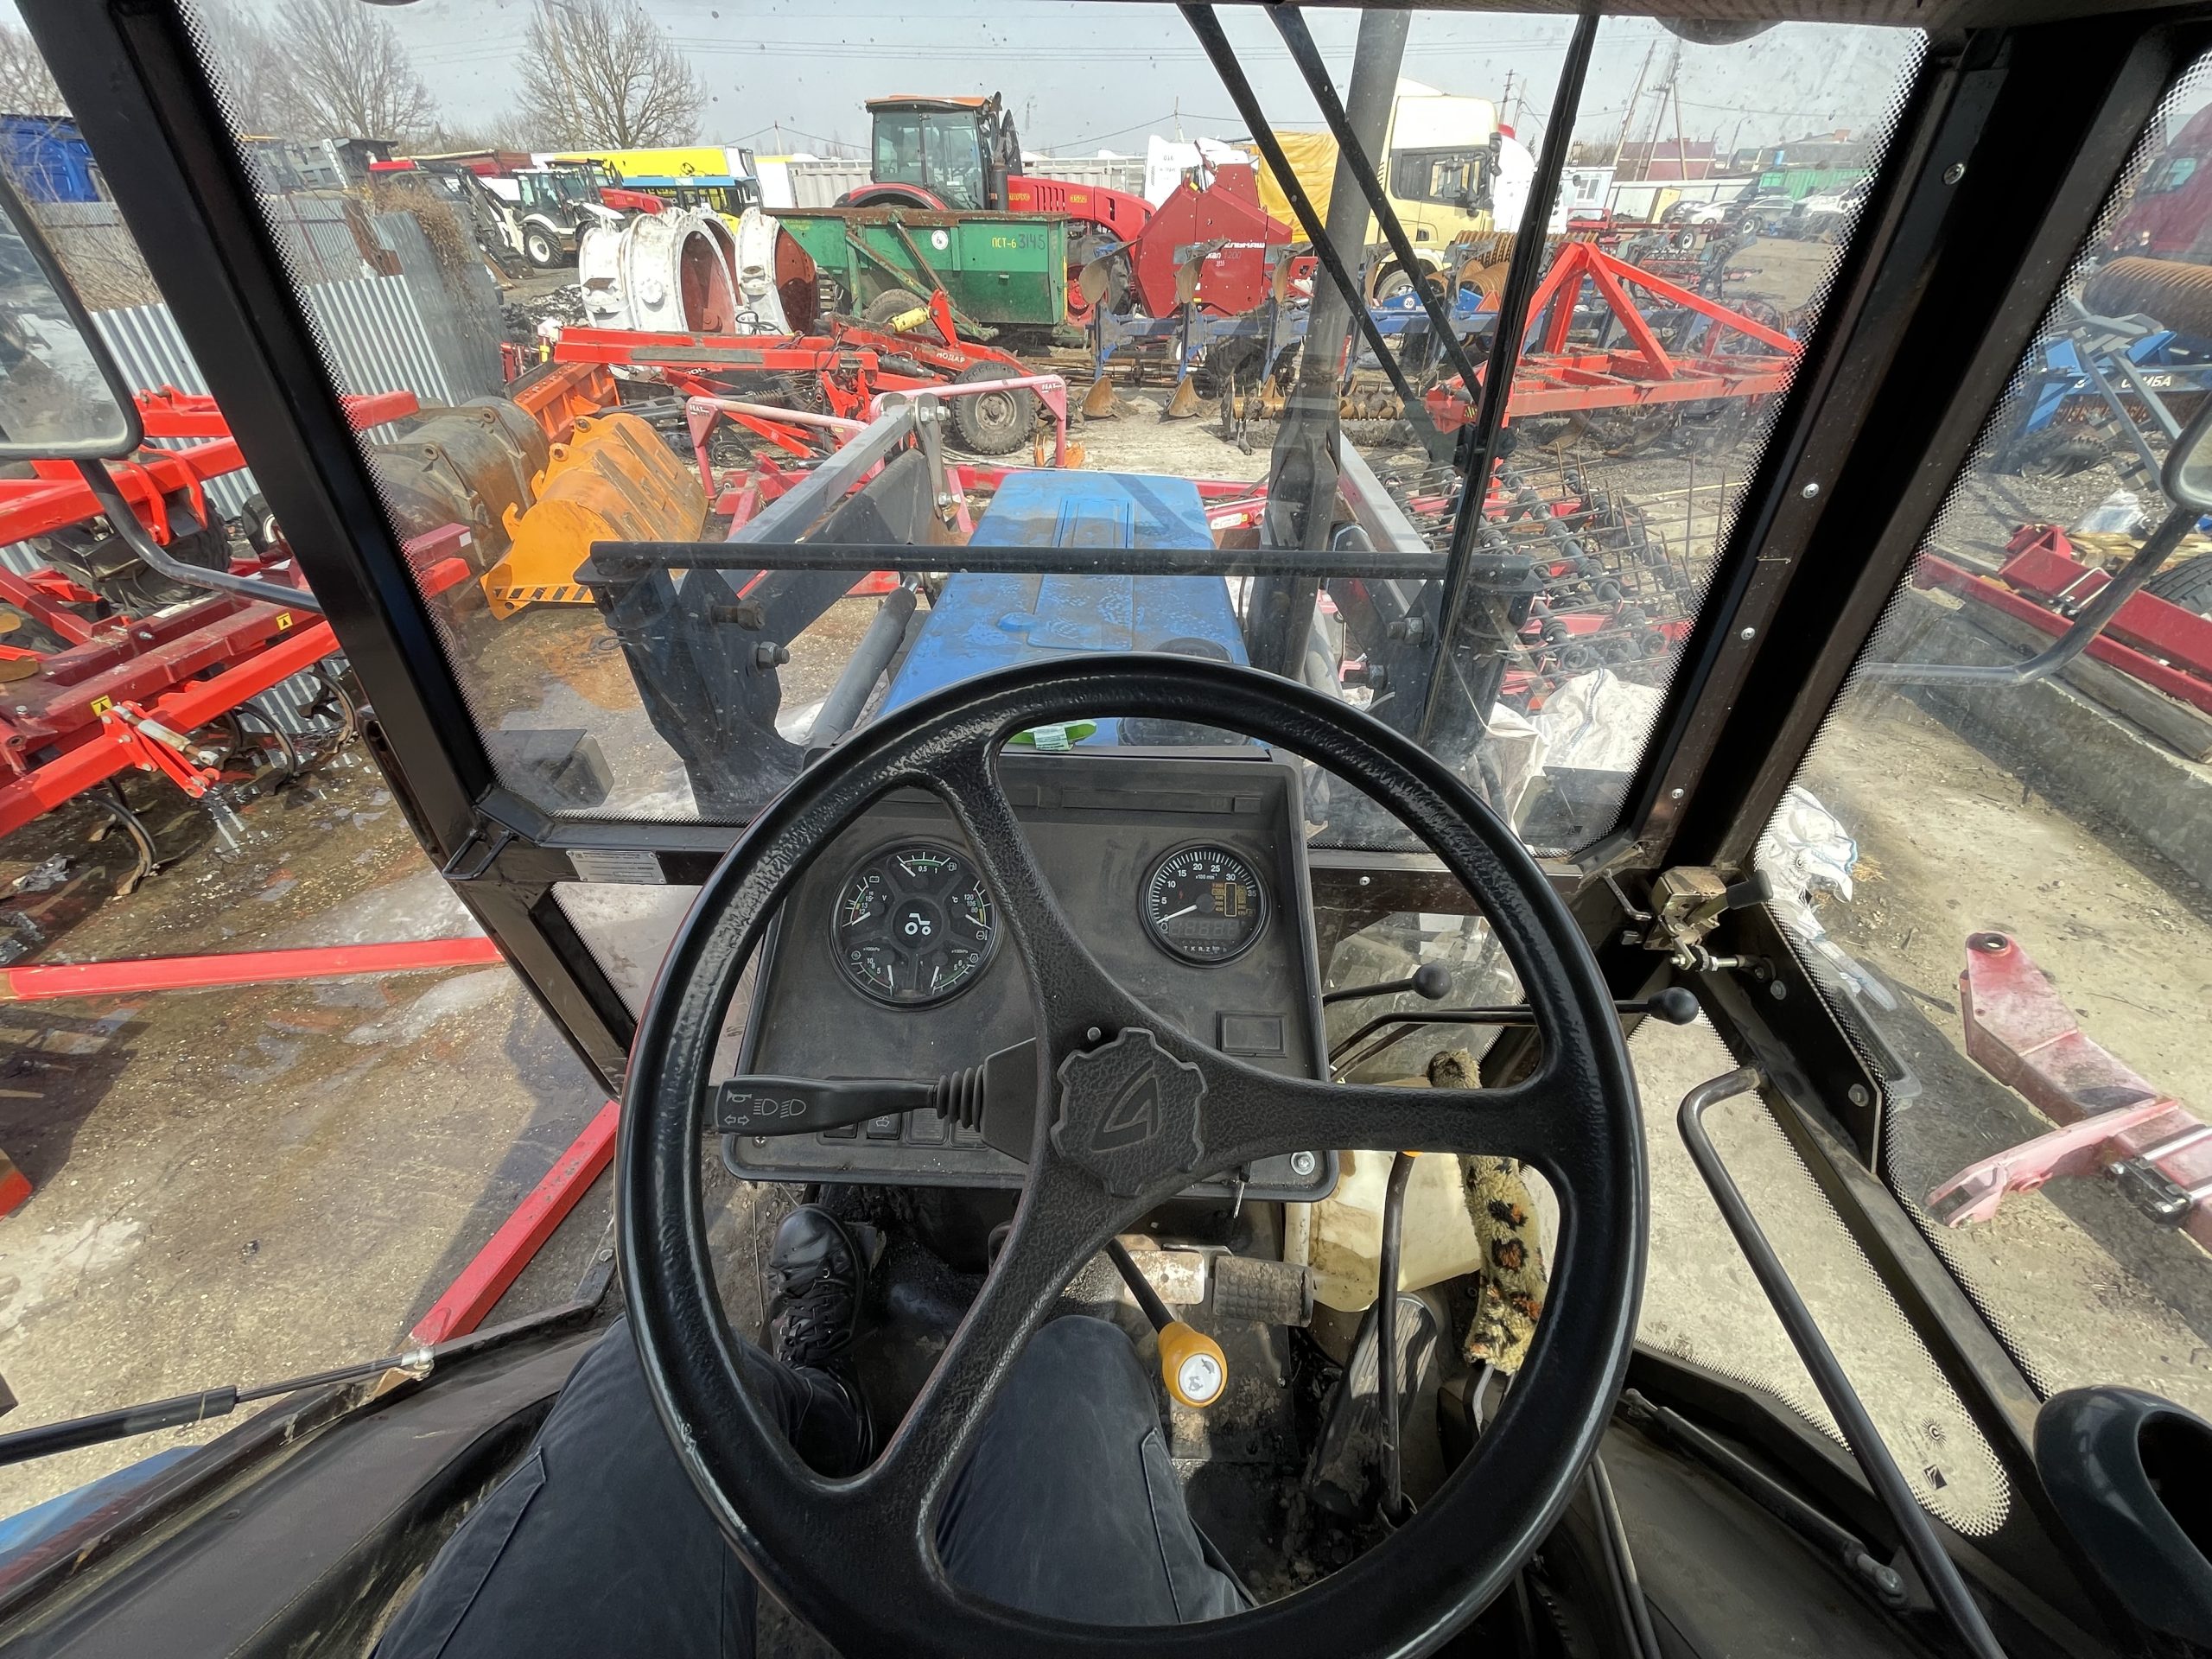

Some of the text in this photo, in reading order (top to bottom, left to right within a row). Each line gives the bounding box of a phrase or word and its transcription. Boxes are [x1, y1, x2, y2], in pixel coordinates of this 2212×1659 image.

[991, 237, 1017, 249] ПСТ-6
[1018, 232, 1046, 251] 3145
[1225, 873, 1236, 881] 30
[1160, 896, 1167, 905] 5
